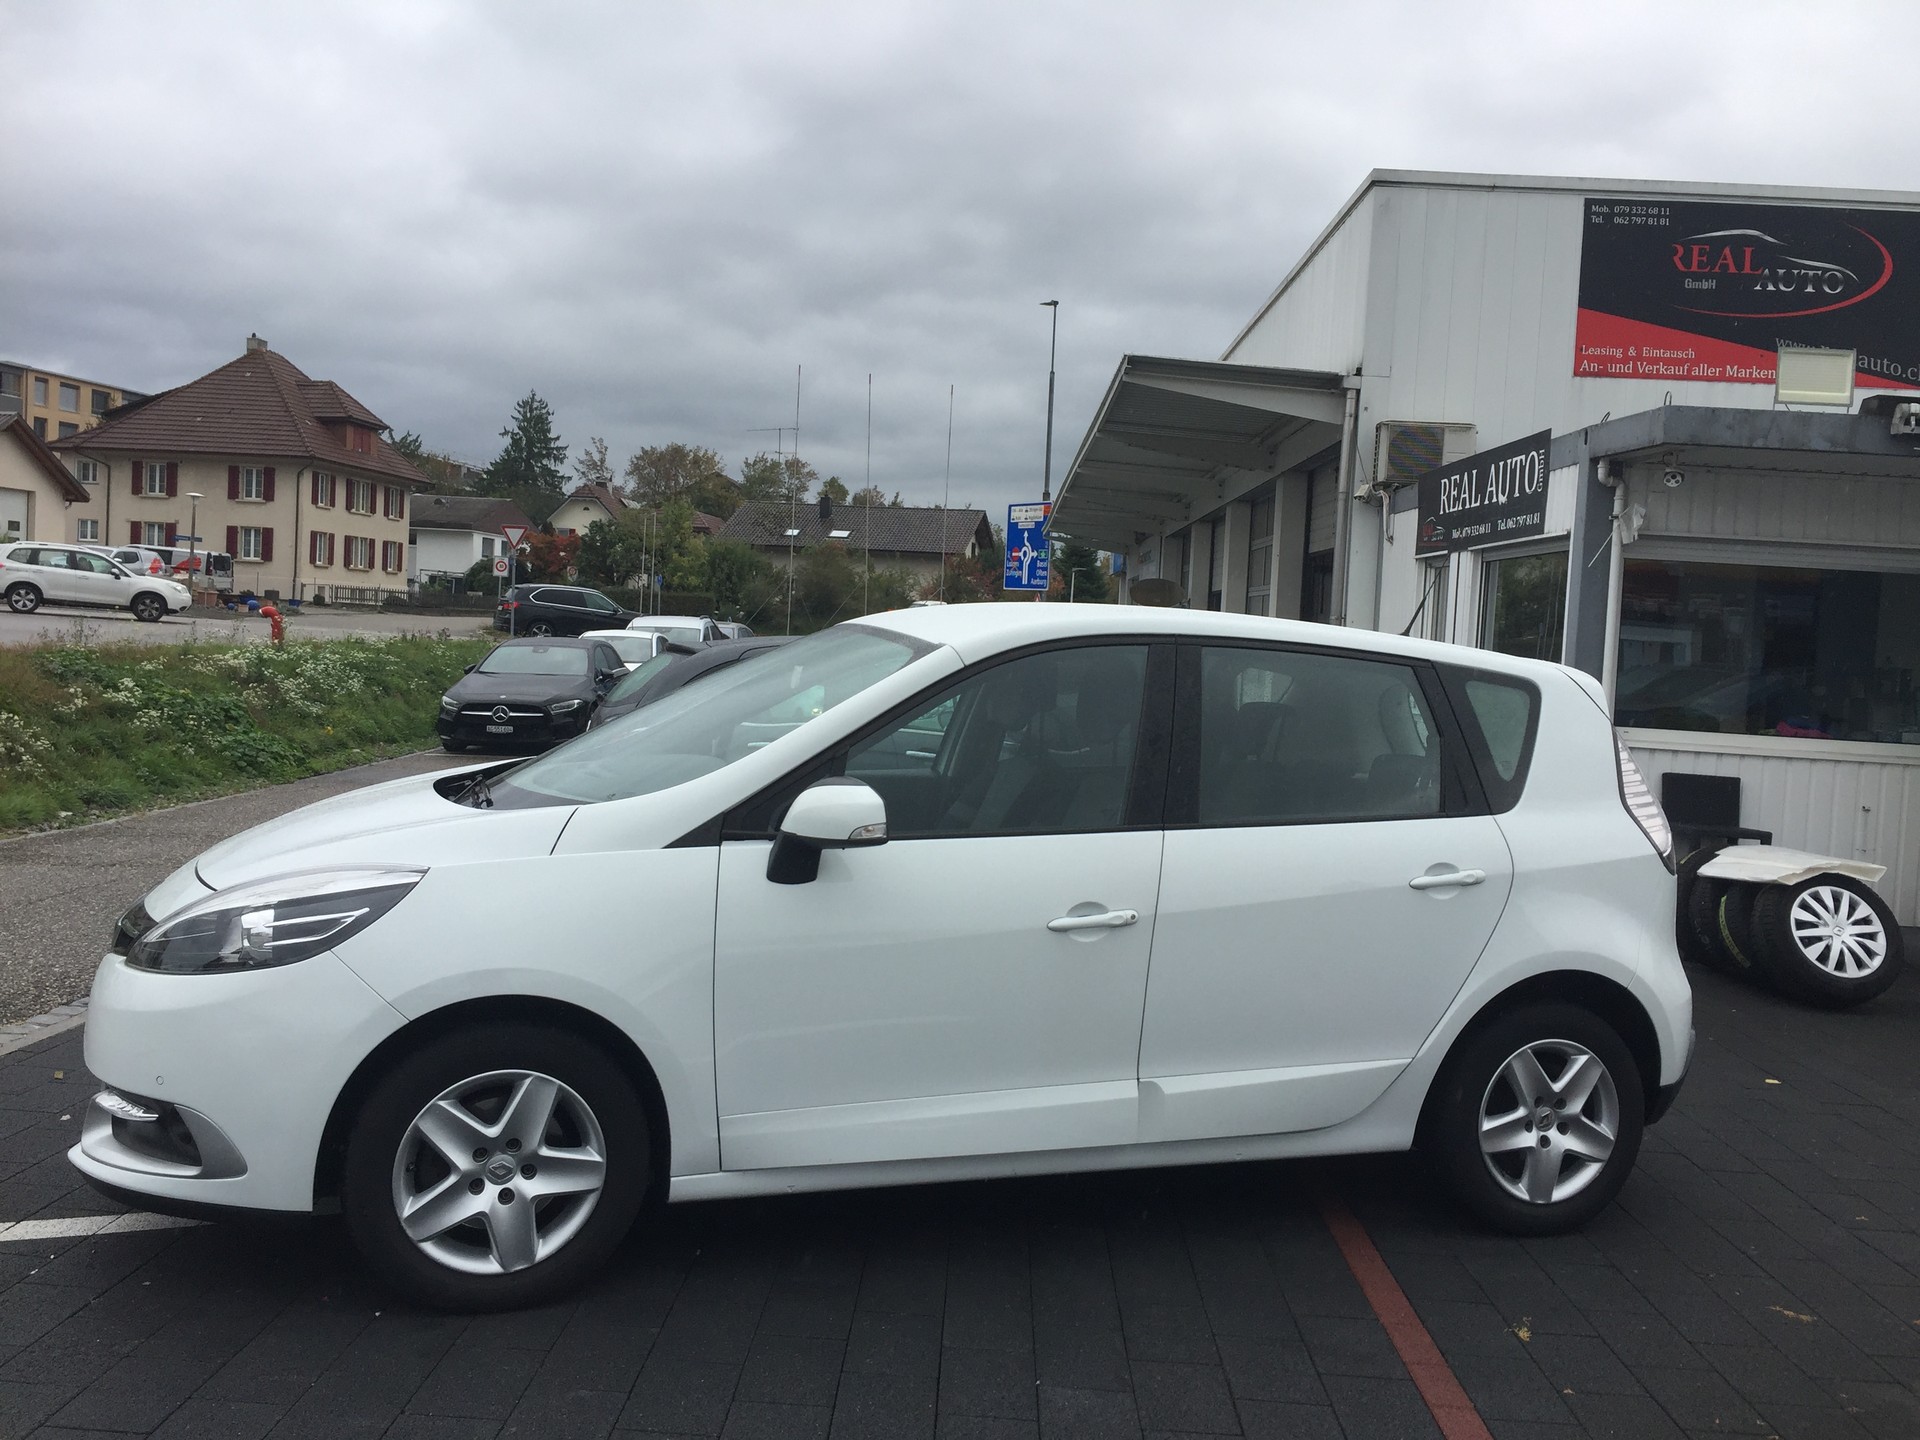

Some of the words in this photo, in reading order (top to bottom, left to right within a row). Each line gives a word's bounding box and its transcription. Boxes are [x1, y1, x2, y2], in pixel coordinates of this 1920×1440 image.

[1591, 204, 1610, 213] Mob.
[1631, 206, 1646, 214] 332
[1672, 244, 1764, 274] REAL
[1684, 278, 1716, 290] GmbH
[1754, 268, 1845, 294] AUTO
[1582, 345, 1623, 358] Leasing
[1628, 347, 1636, 357] &
[1642, 347, 1695, 358] Eintausch
[1580, 360, 1604, 372] An-
[1608, 361, 1633, 373] und
[1637, 362, 1689, 375] Verkauf
[1693, 364, 1722, 376] aller
[1726, 365, 1776, 379] Marken
[1439, 469, 1481, 515] REAL
[1484, 451, 1539, 504] AUTO
[1537, 449, 1545, 492] GmbH
